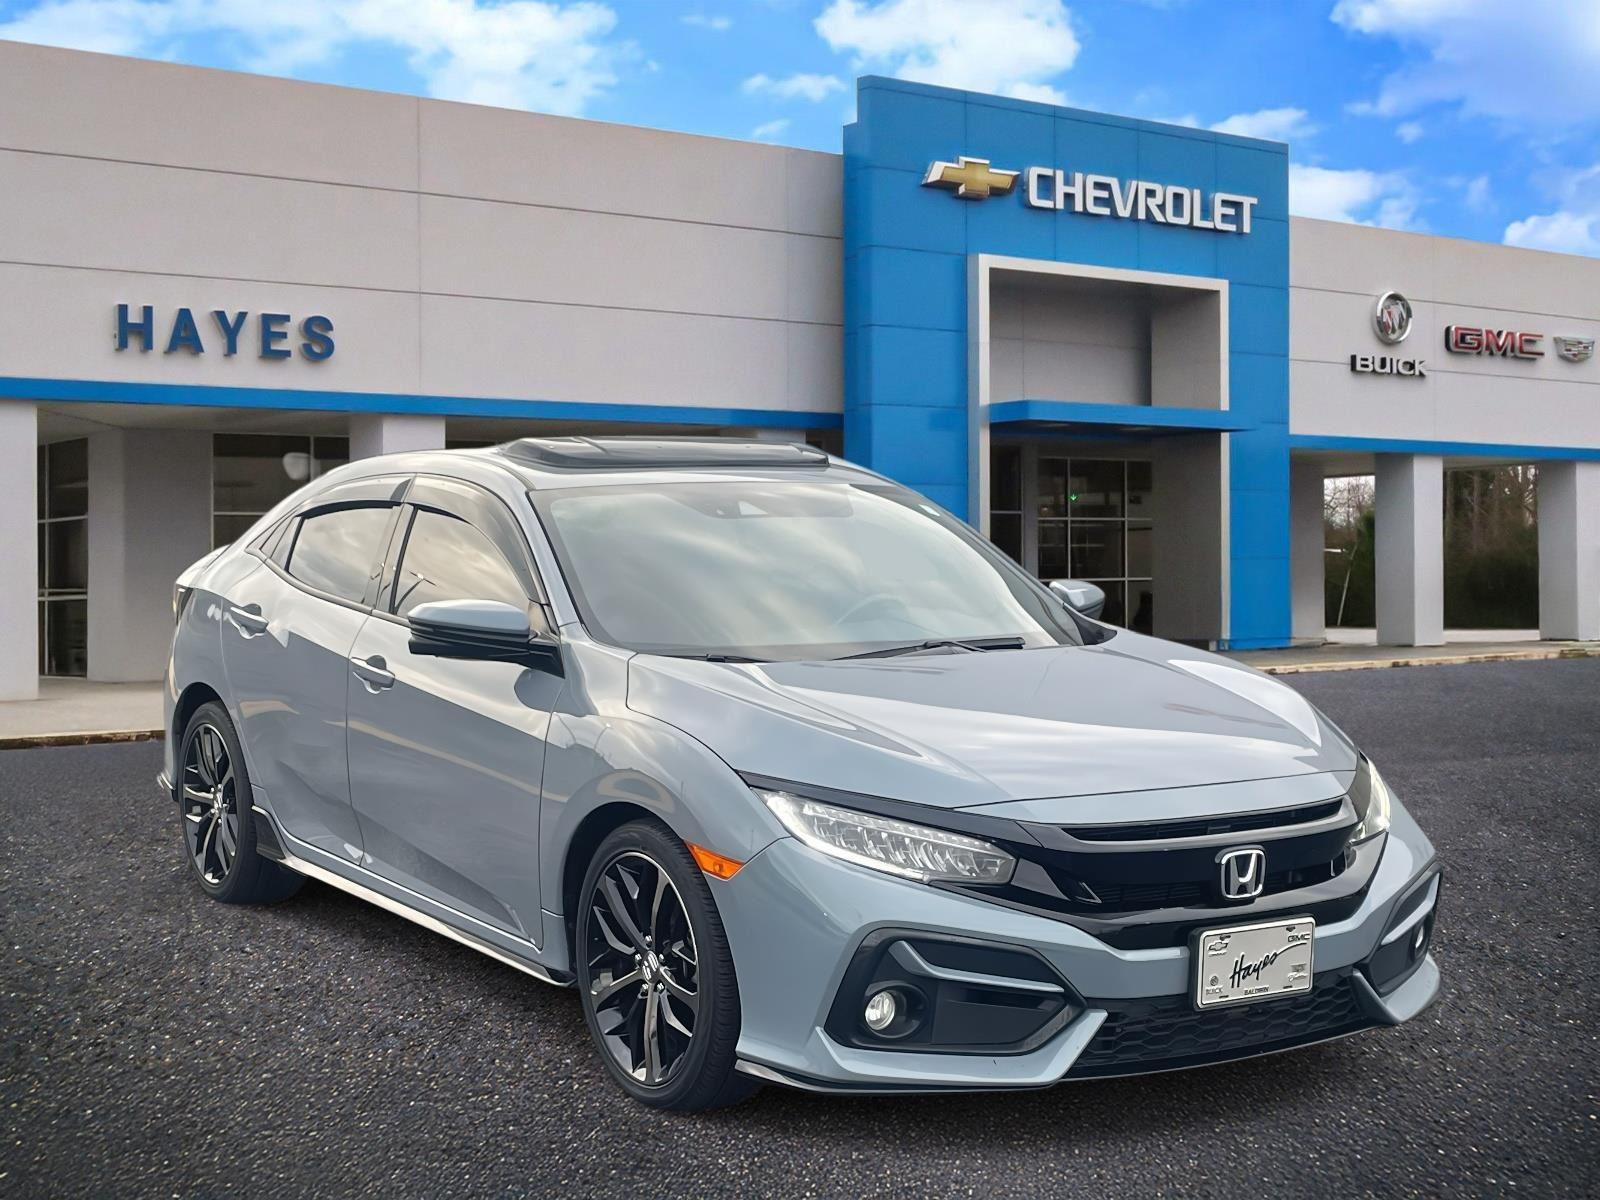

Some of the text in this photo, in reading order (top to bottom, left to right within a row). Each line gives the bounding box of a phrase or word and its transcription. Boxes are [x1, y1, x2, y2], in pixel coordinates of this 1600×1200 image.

[1026, 165, 1258, 235] CHEVROLET
[113, 303, 336, 362] HAYES
[1445, 324, 1545, 361] GMC
[1350, 353, 1427, 377] BUICK
[1288, 934, 1311, 942] GMC
[1229, 943, 1306, 988] Hayes
